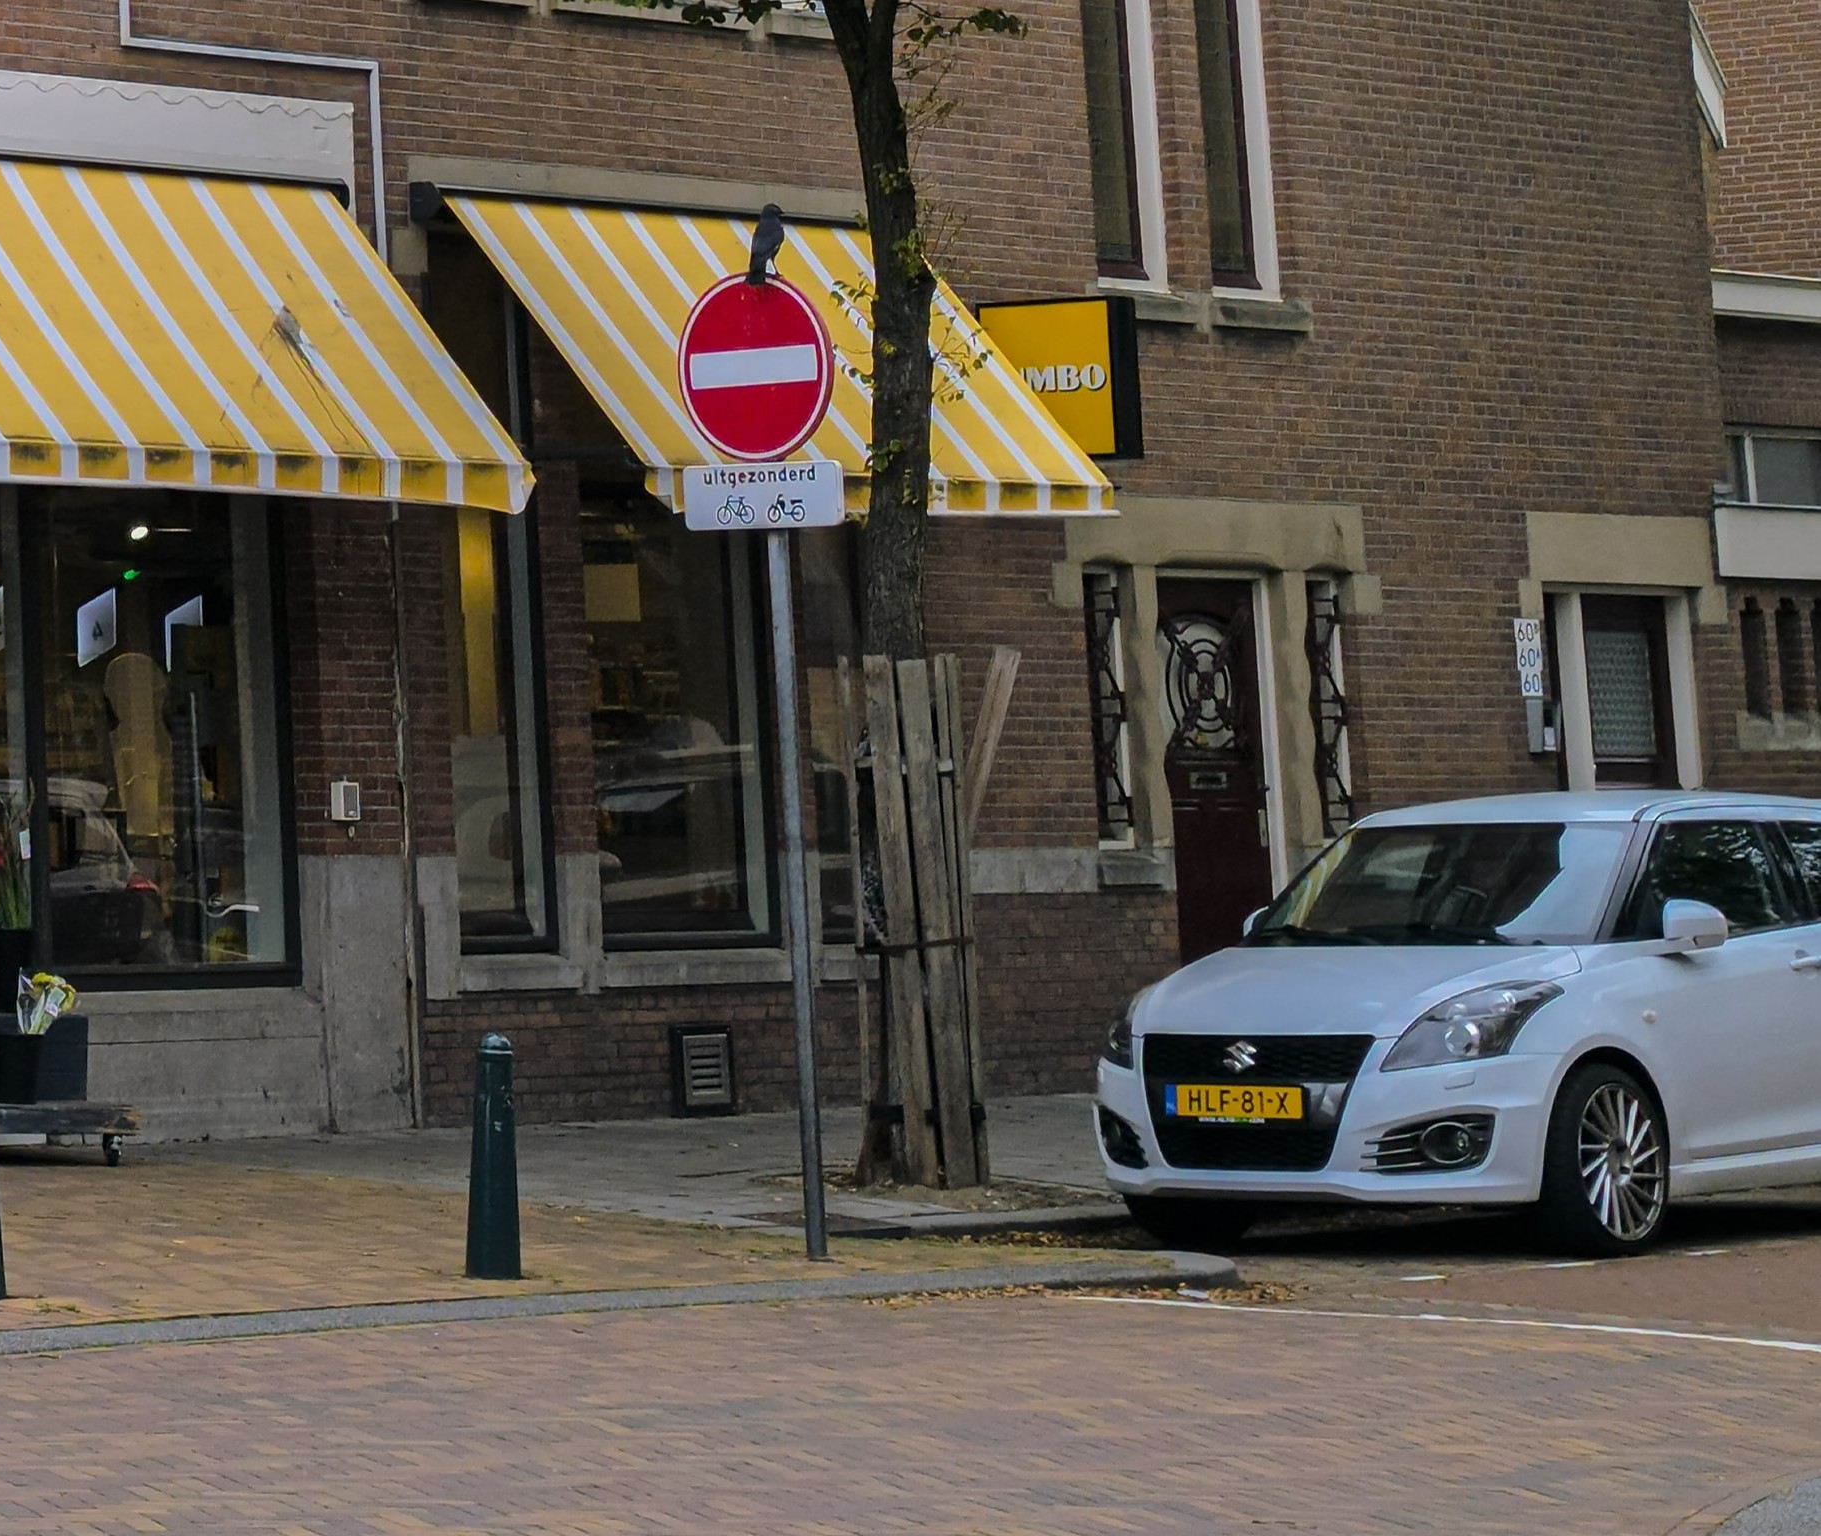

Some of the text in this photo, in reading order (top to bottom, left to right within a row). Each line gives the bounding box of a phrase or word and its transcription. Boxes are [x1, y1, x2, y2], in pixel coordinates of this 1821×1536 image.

[1019, 363, 1107, 393] MBO
[703, 465, 816, 488] uitgezonderd
[1523, 673, 1540, 693] 60
[1188, 1089, 1290, 1115] HLF-81-X
